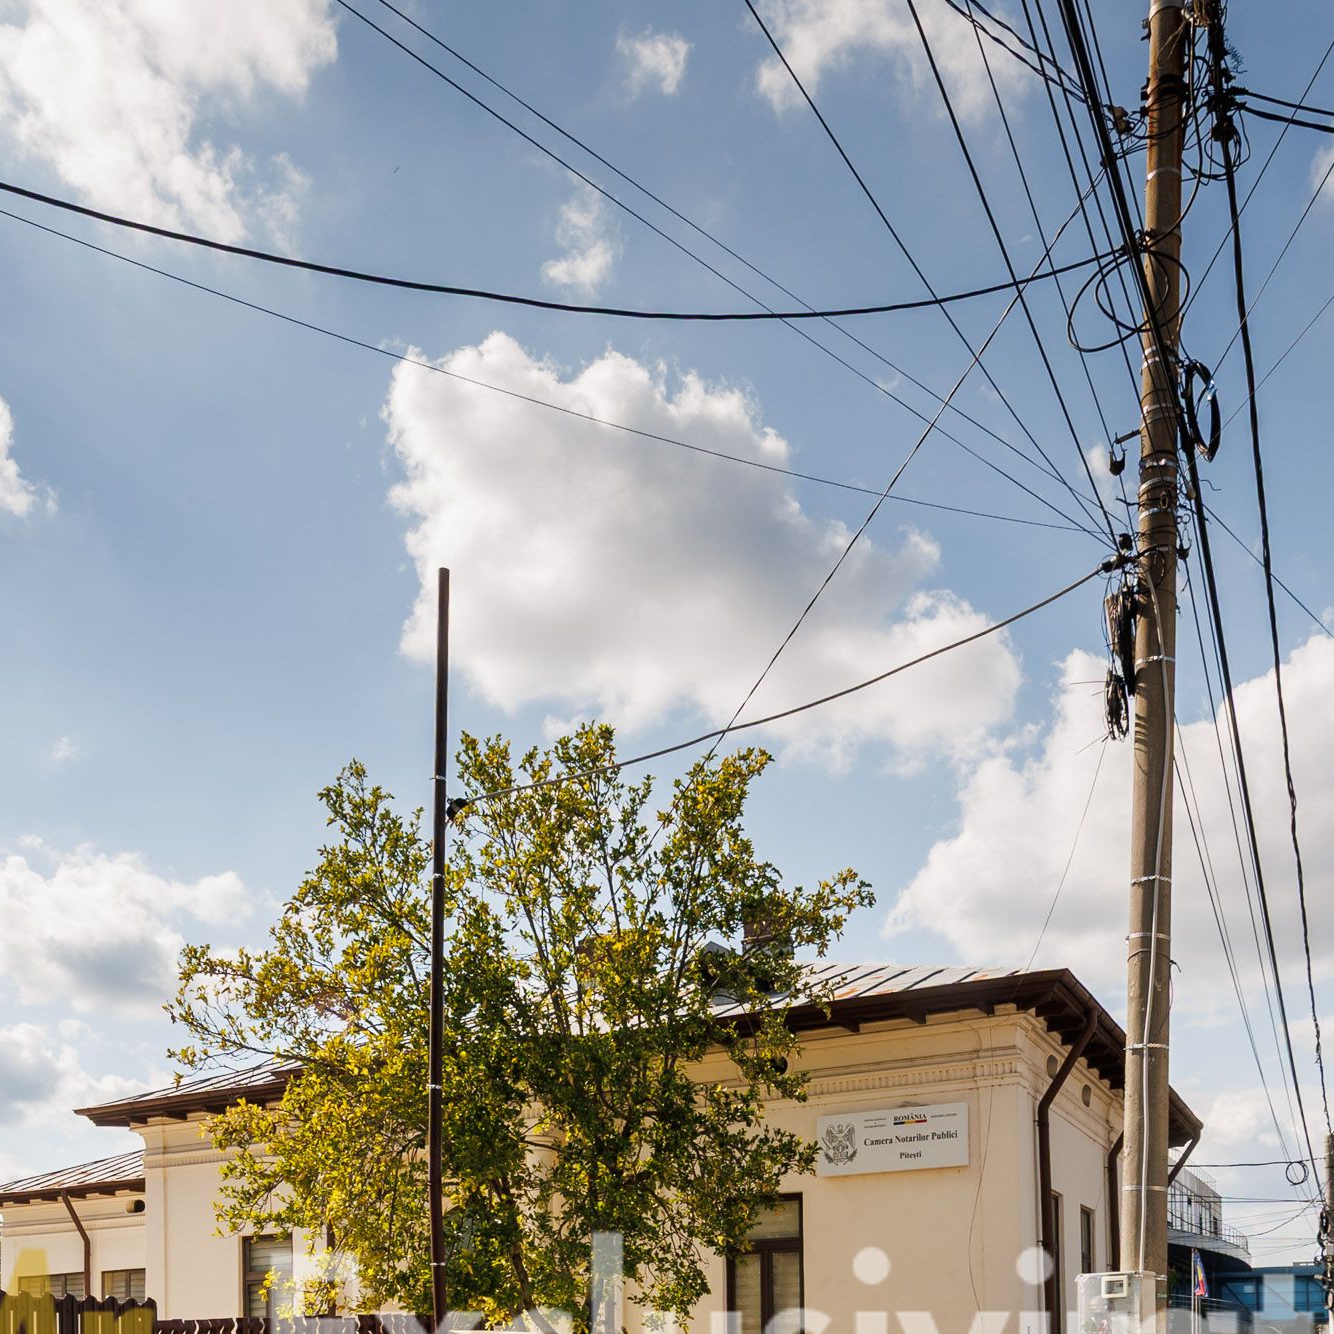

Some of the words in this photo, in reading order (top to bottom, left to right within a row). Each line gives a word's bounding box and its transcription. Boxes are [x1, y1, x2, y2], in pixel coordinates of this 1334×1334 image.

[893, 1113, 927, 1121] ROMÂNIA
[864, 1138, 893, 1146] Camera
[895, 1133, 929, 1143] Notarilor
[931, 1130, 958, 1140] Publici
